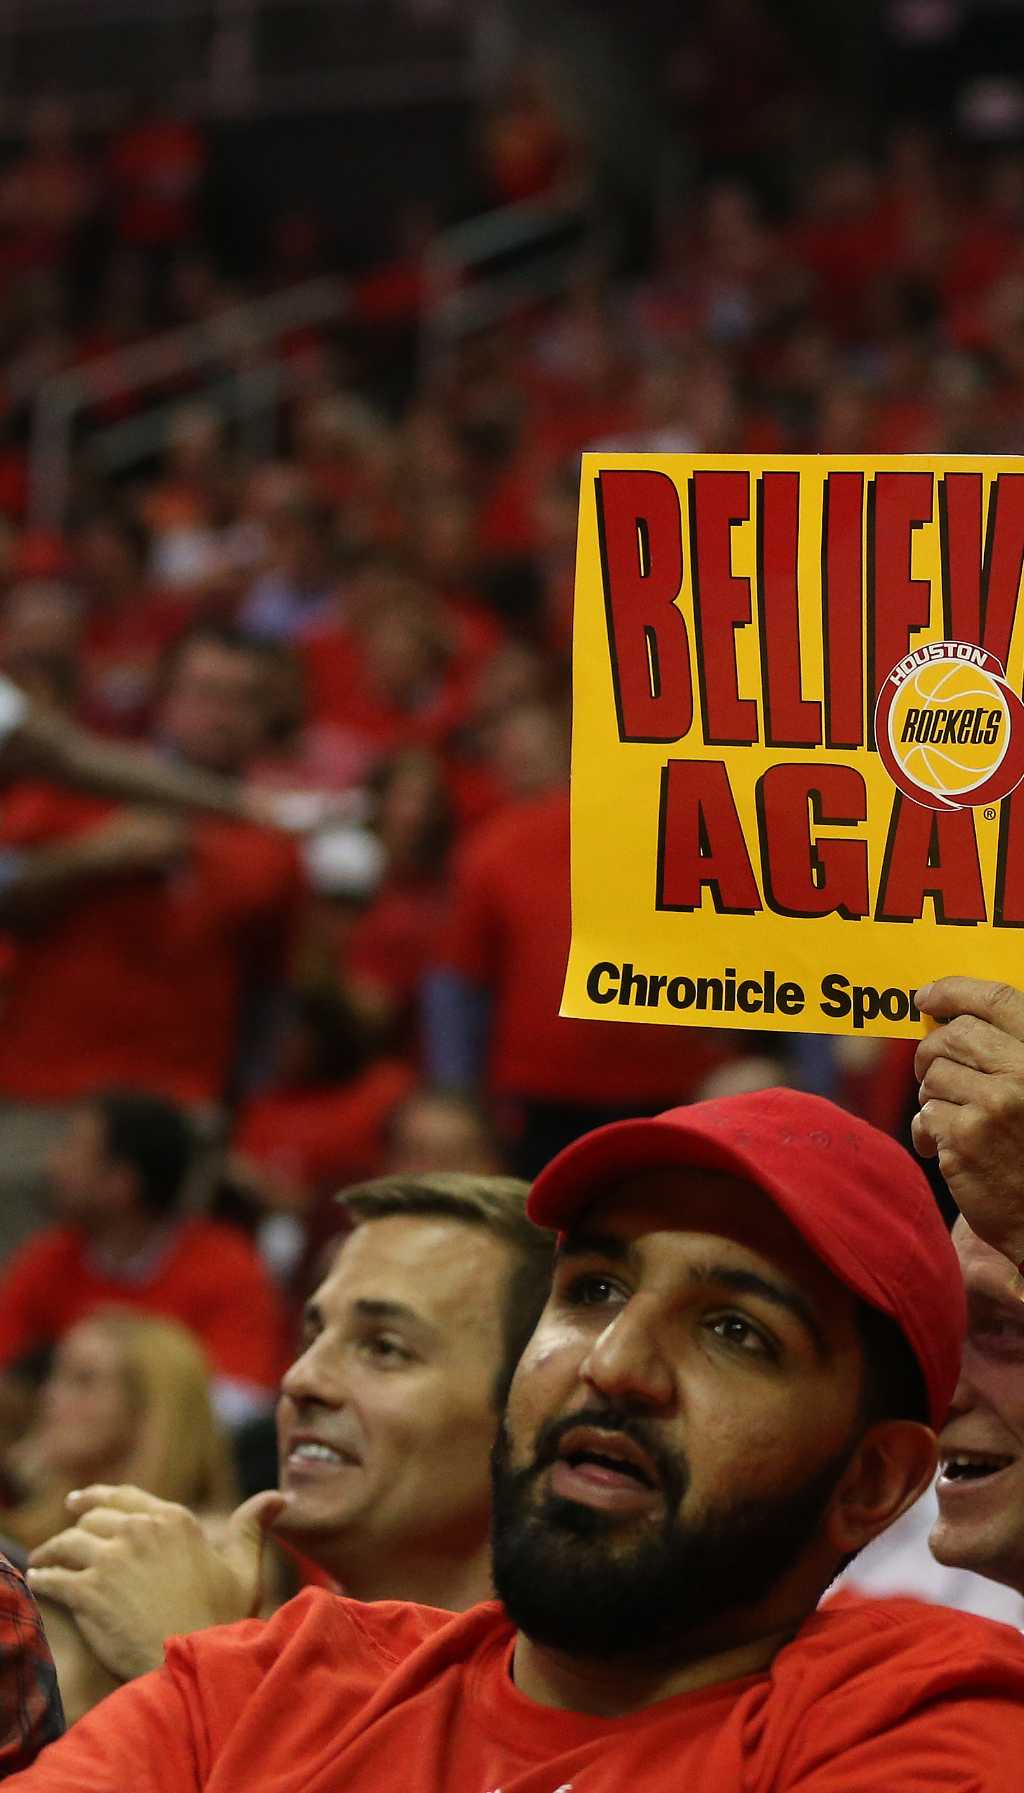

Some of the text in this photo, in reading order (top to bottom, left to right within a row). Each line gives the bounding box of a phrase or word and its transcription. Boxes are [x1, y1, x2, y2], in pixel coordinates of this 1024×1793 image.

[890, 643, 988, 686] HOUSTON
[586, 961, 921, 1029] Chronicle Spor
